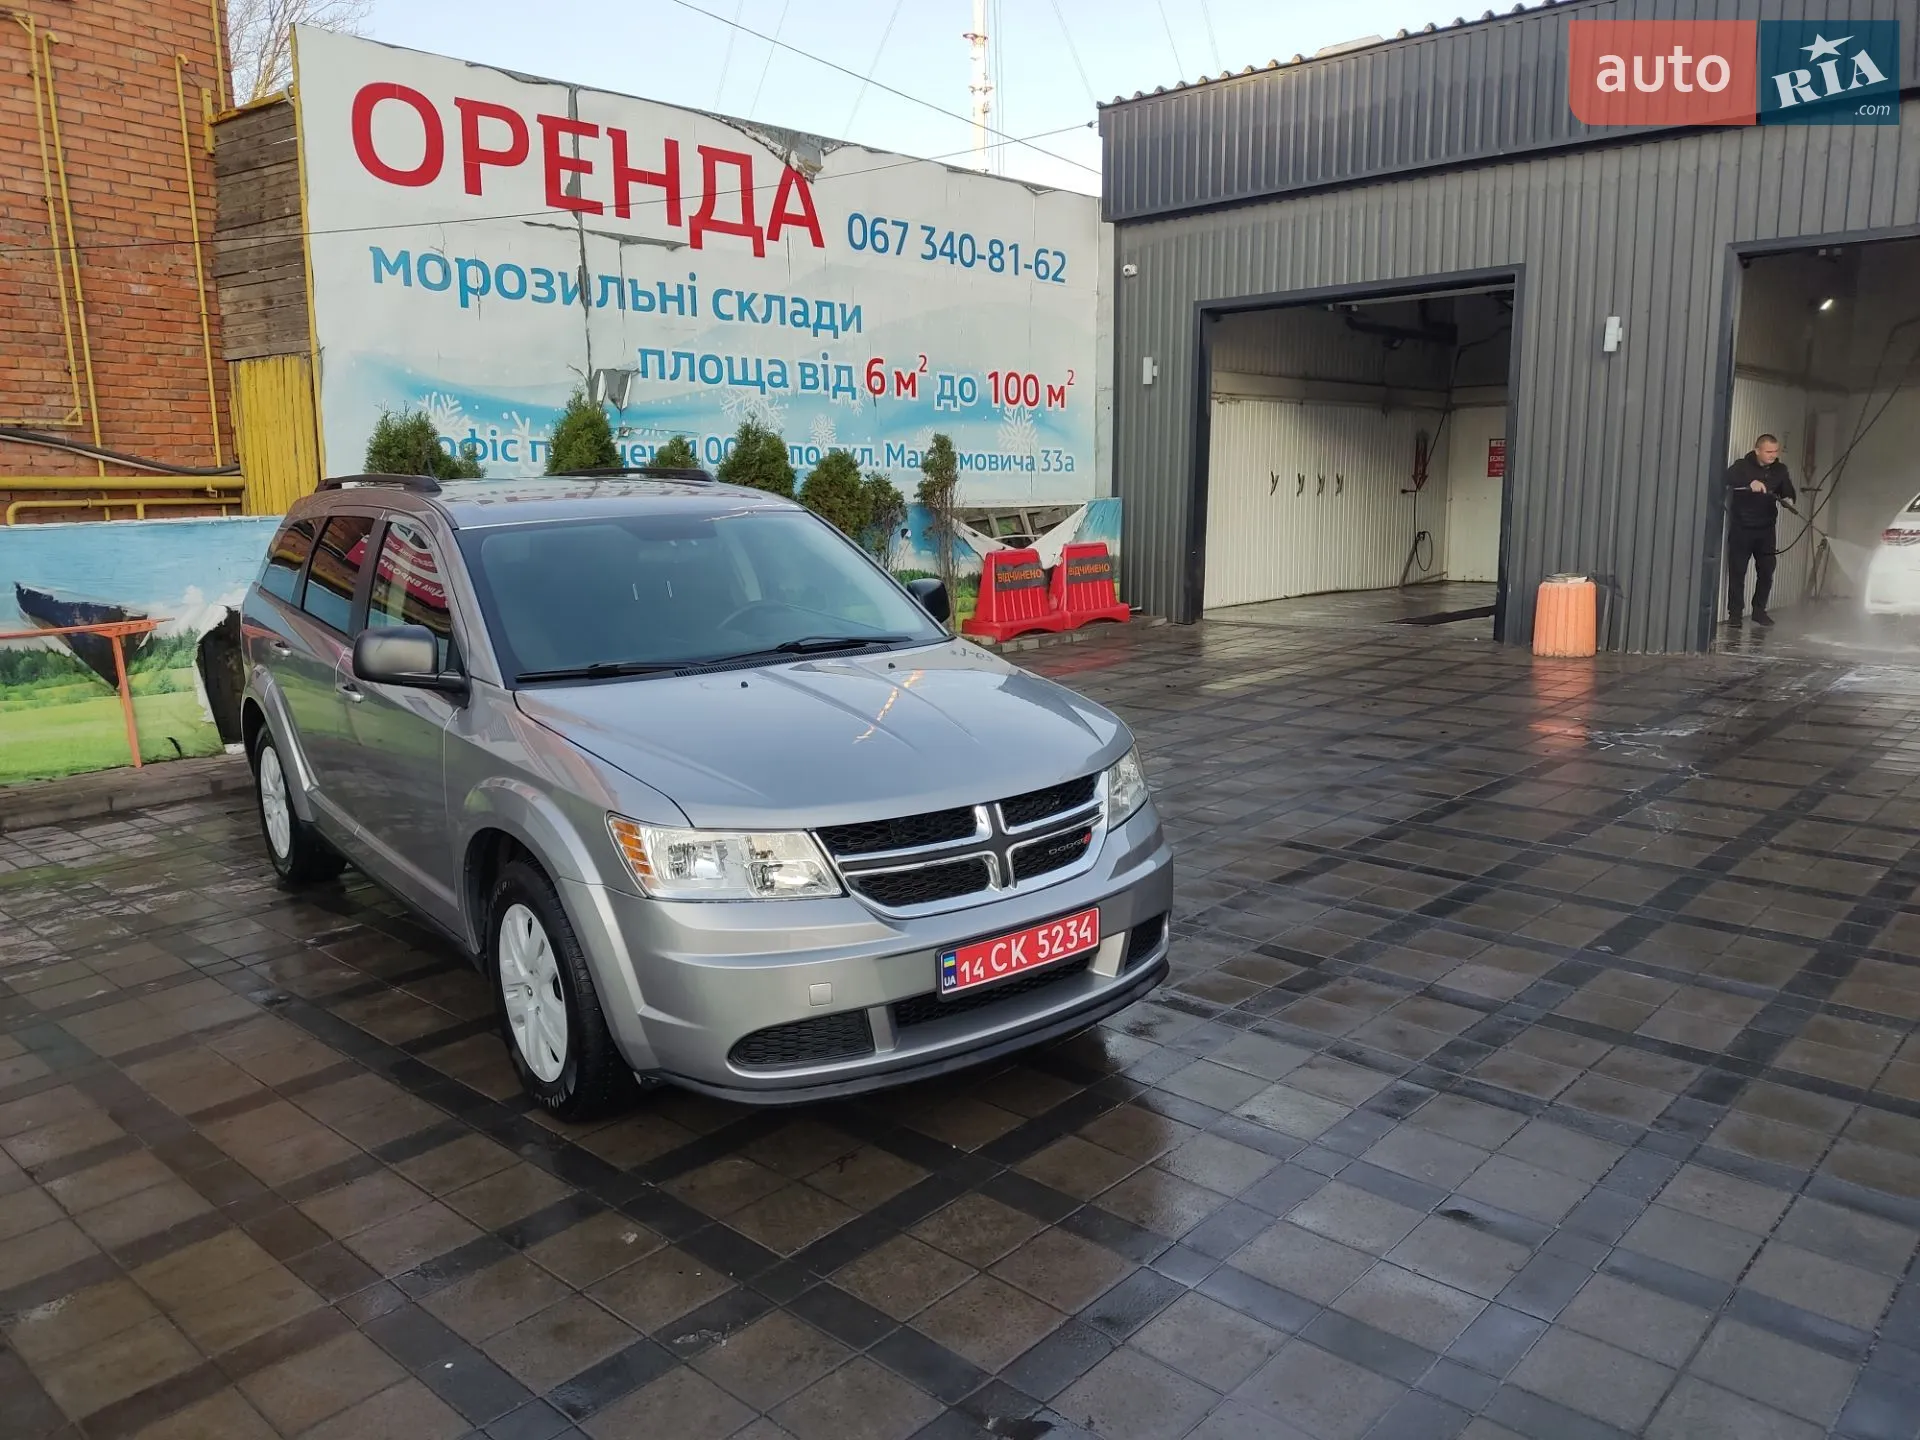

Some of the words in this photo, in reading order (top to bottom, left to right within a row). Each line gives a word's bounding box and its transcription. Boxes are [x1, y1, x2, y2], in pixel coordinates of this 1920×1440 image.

[351, 81, 826, 258] ОРЕНДА
[847, 212, 909, 257] 067
[920, 224, 1067, 284] 340-81-62
[369, 246, 699, 317] морозильні
[712, 287, 863, 339] склади
[639, 348, 788, 395] площа
[799, 352, 857, 400] від
[866, 357, 886, 397] 6
[936, 373, 977, 407] до
[987, 371, 1040, 408] 100
[788, 445, 821, 466] по
[1040, 449, 1076, 473] 33а
[997, 568, 1043, 583] ВІДЧИНЕНО
[1068, 563, 1110, 577] ВІДЧИНЕНО
[960, 956, 985, 984] 14
[1037, 915, 1092, 959] 5234
[943, 976, 957, 987] UA
